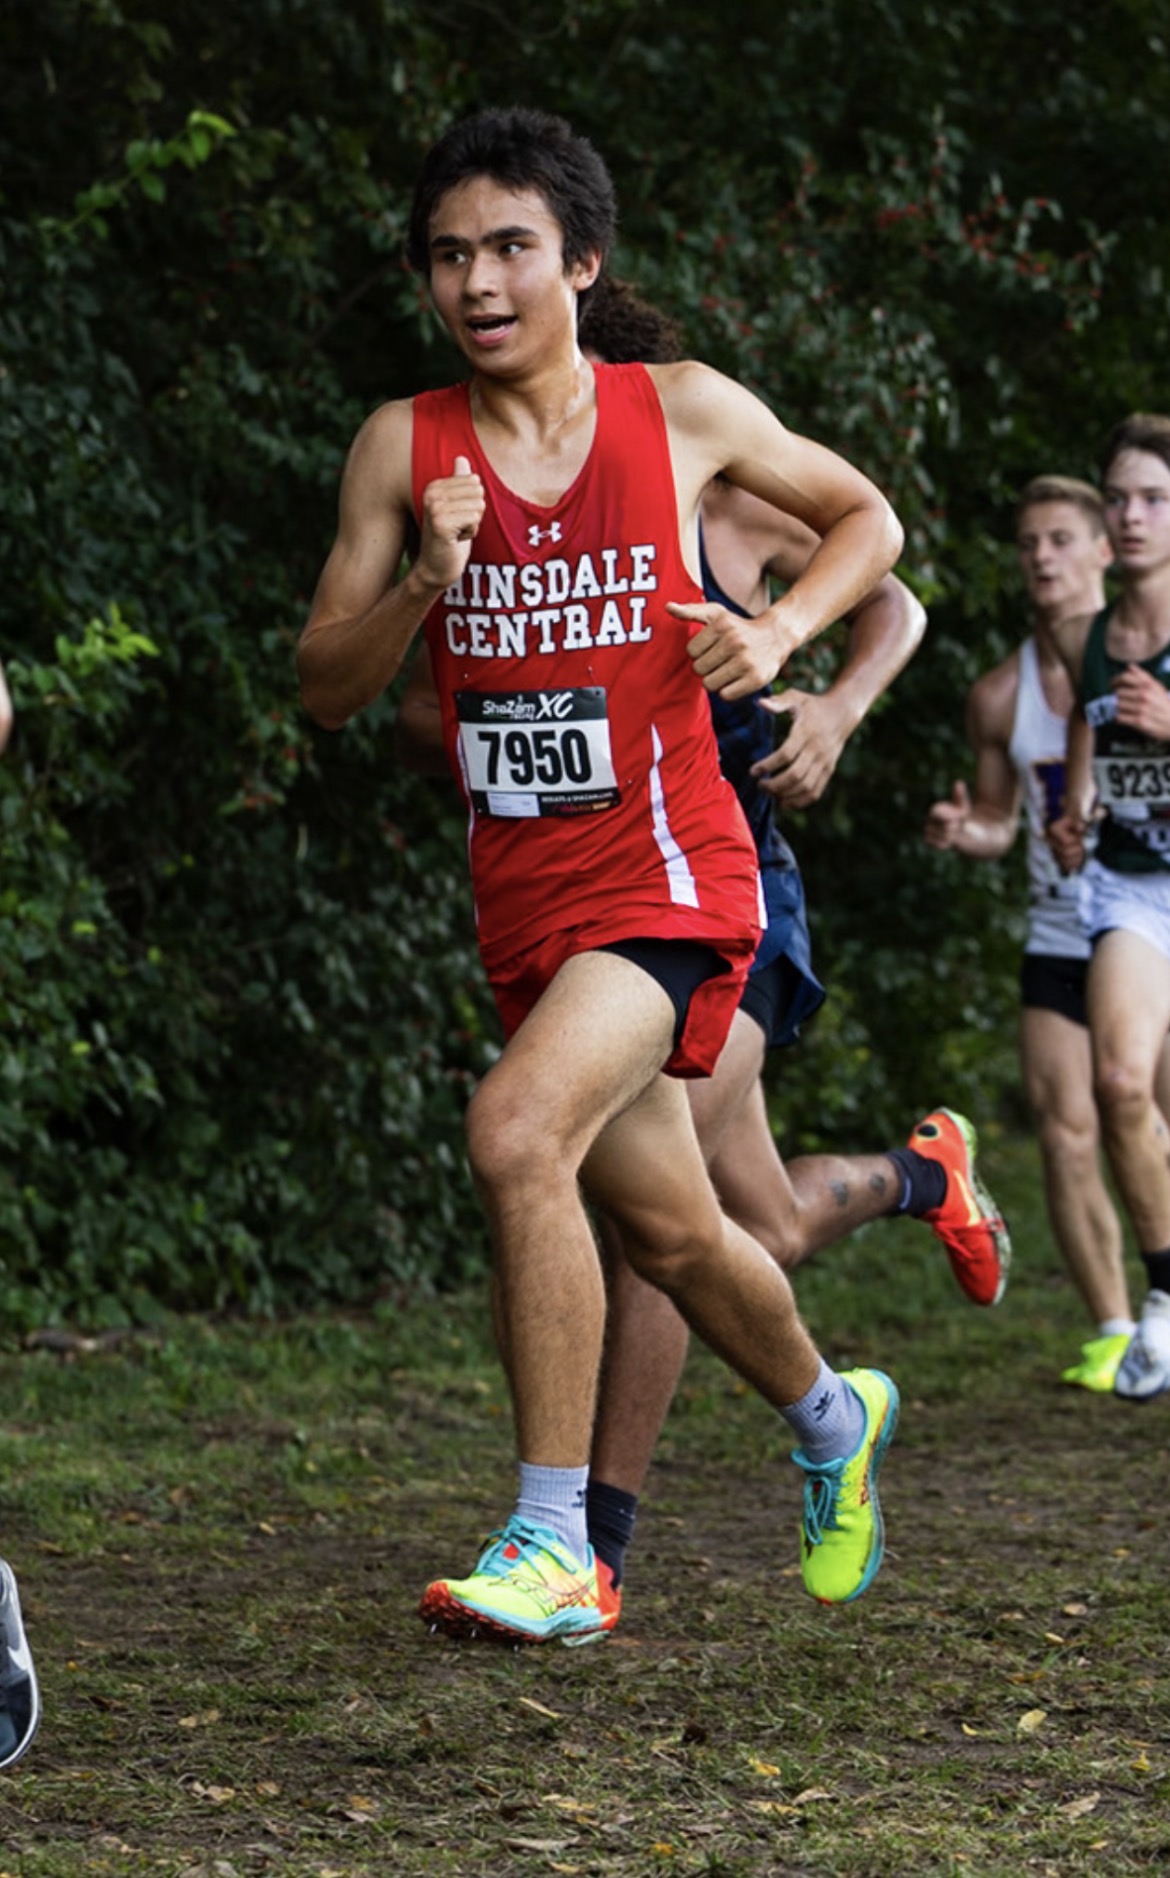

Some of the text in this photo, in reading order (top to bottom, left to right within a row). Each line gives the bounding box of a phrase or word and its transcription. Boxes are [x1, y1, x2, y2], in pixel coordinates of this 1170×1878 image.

[445, 596, 652, 658] CENTRAL
[536, 691, 574, 720] XC
[477, 729, 592, 786] 7950
